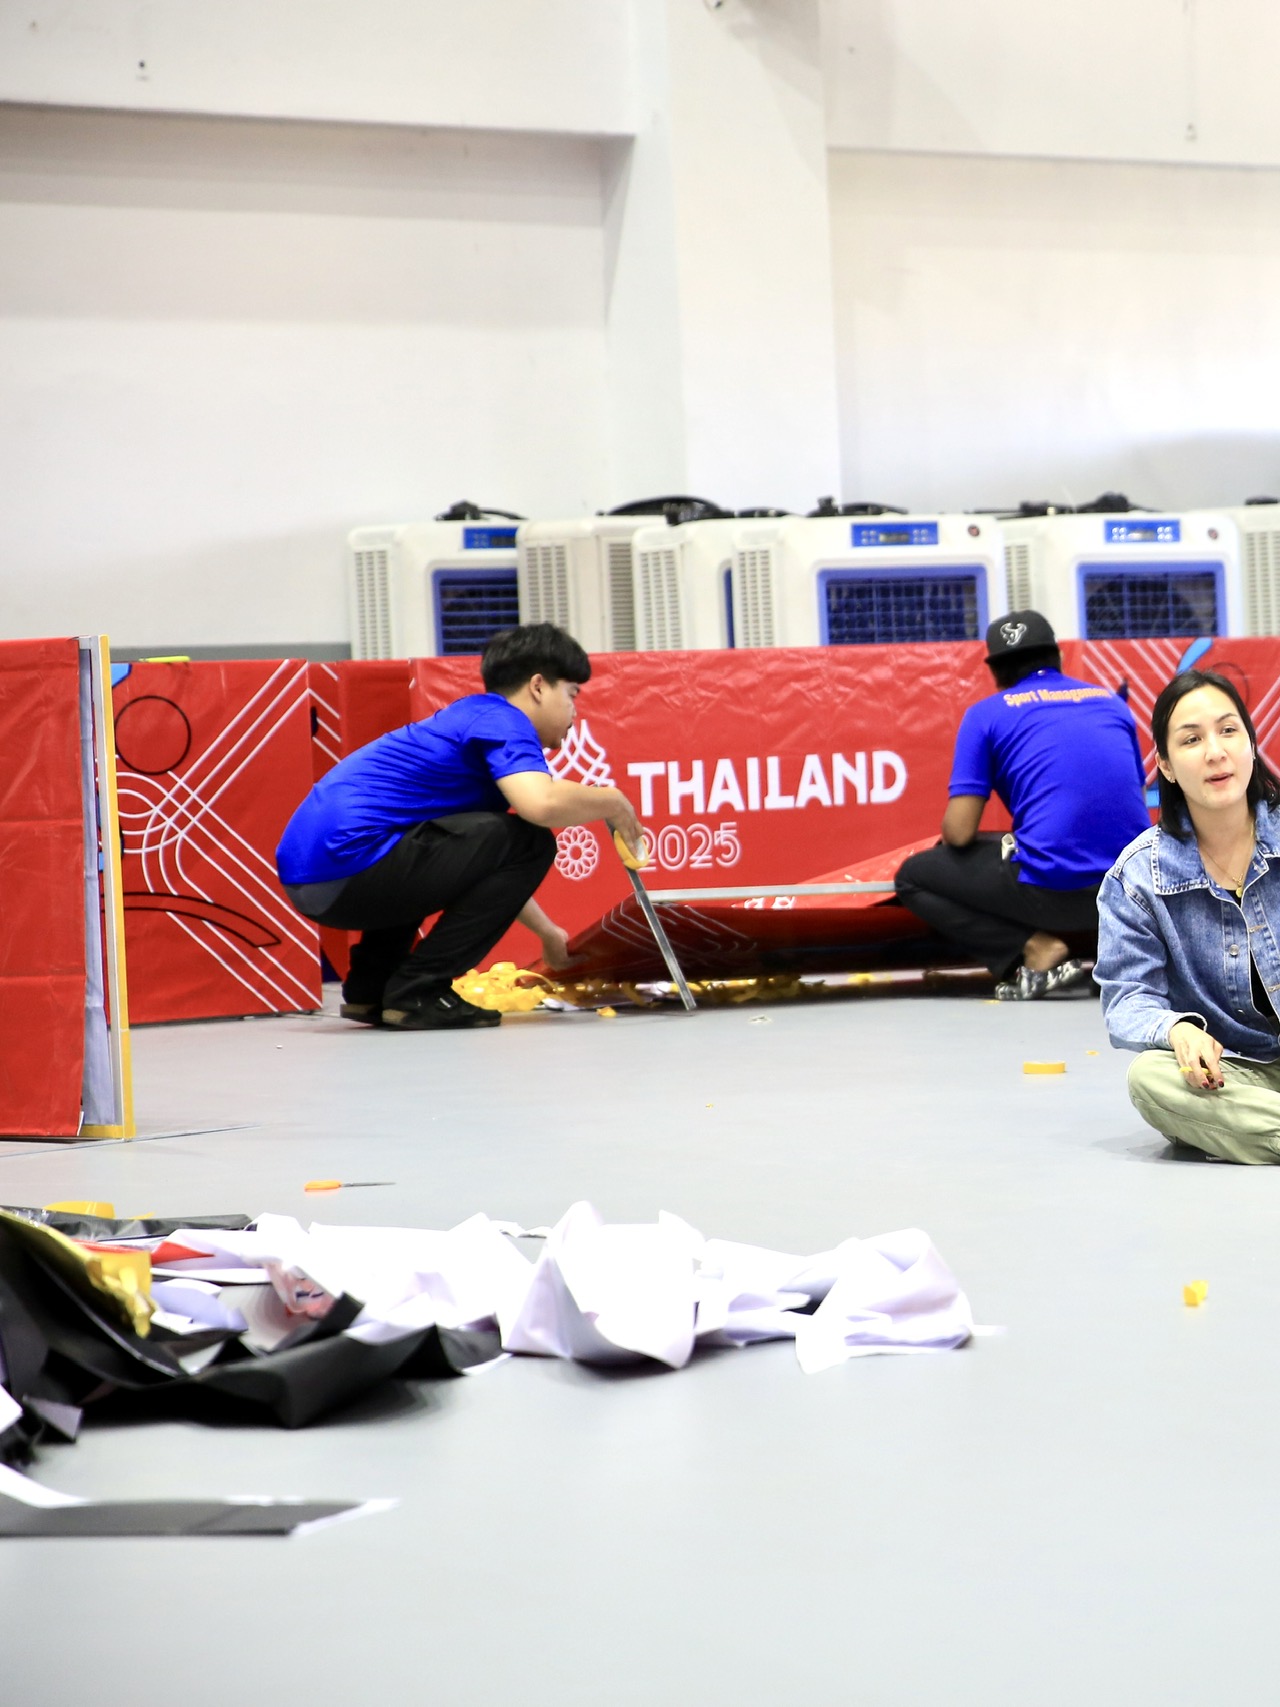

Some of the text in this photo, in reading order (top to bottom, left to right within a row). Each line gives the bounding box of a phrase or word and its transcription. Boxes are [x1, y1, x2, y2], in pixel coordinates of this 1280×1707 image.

[1003, 690, 1039, 707] Sport
[627, 750, 908, 817] THAILAND
[638, 821, 741, 873] 2025
